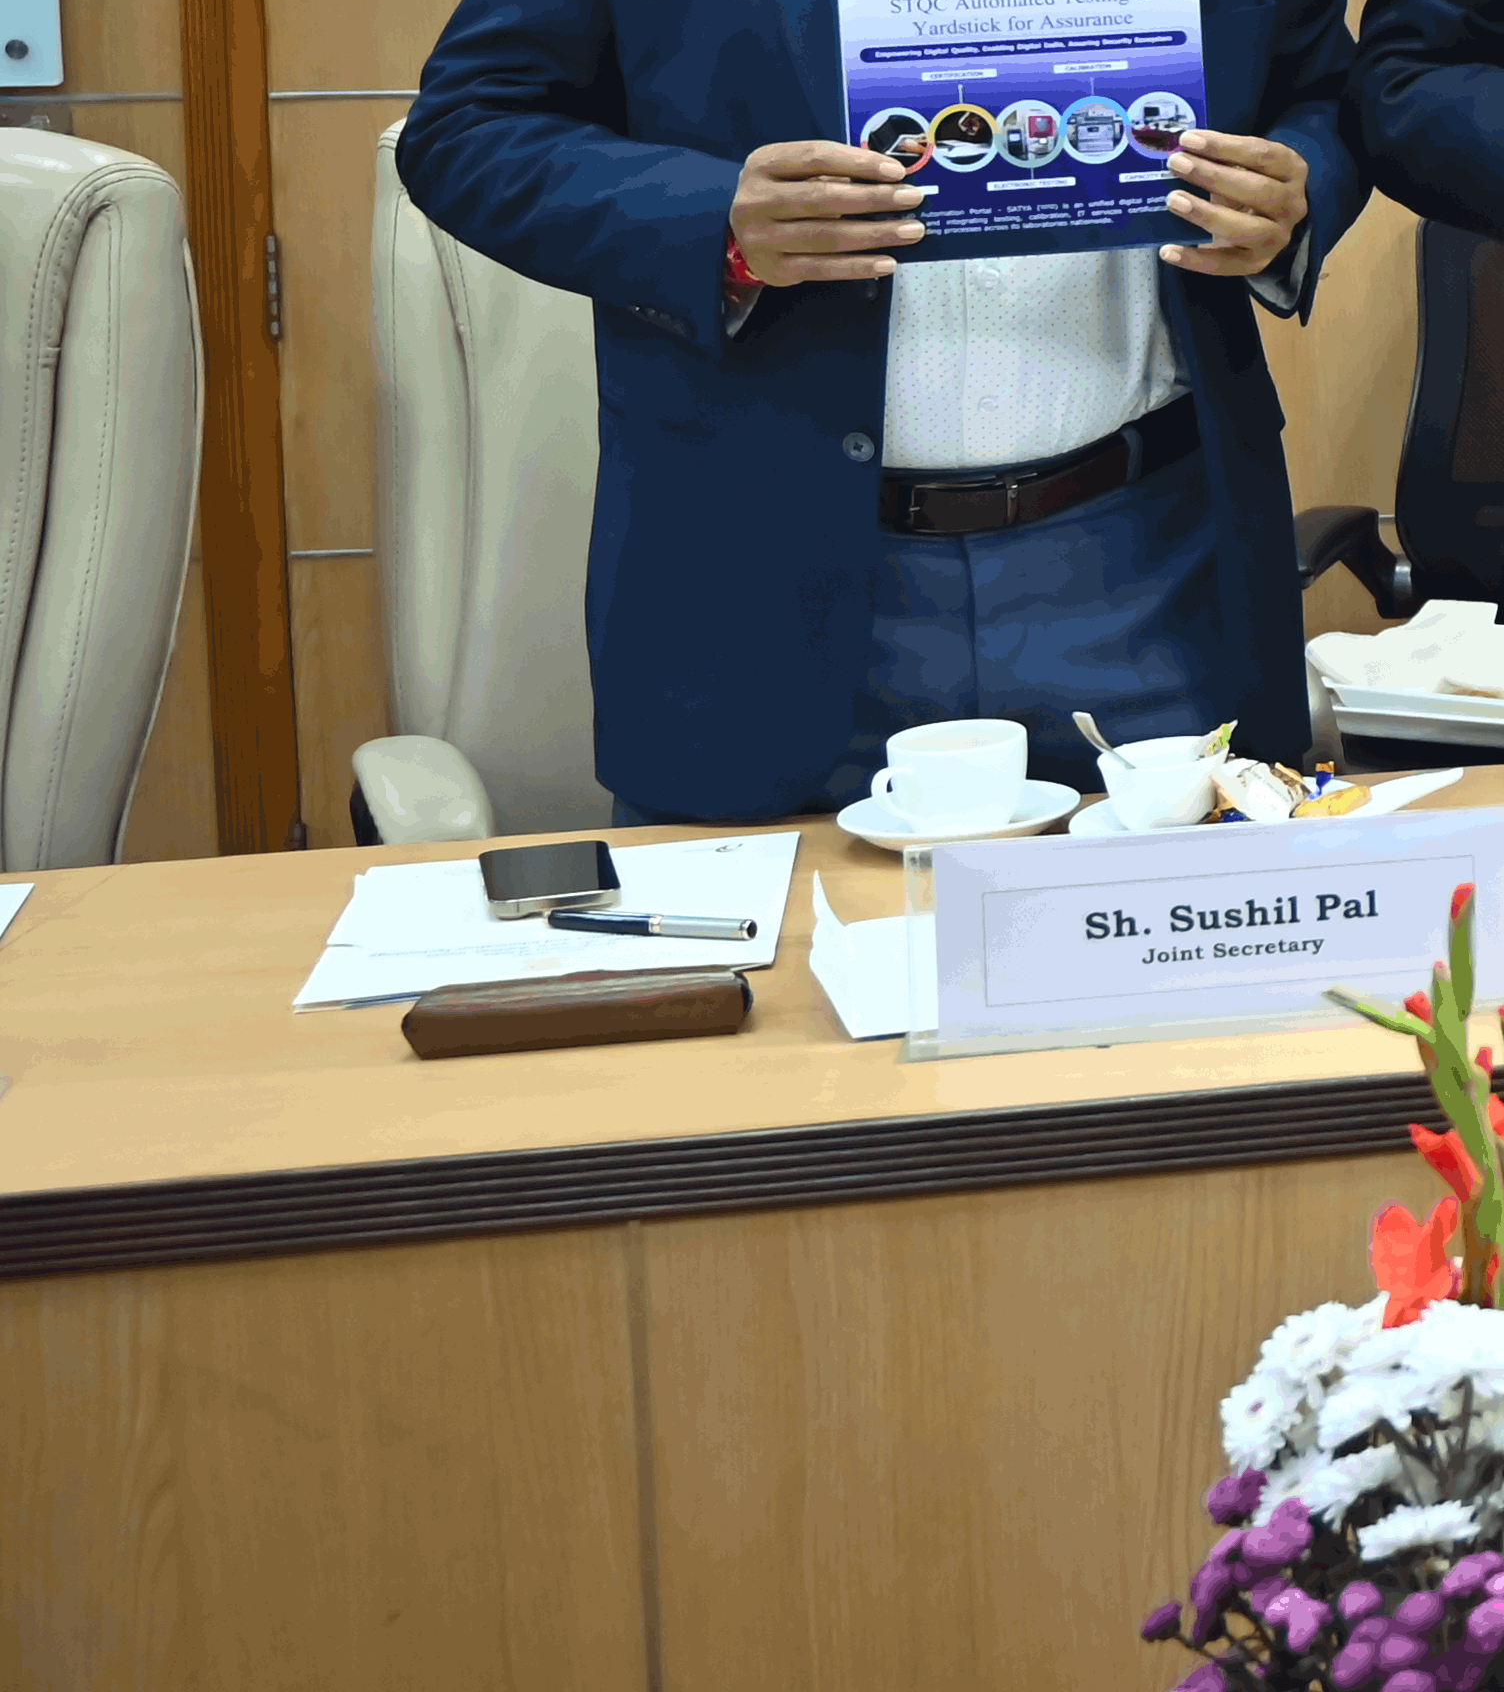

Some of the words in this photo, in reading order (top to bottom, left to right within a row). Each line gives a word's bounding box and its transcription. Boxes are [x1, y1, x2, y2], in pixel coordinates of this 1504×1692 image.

[913, 19, 1002, 37] Yardstick
[1009, 18, 1034, 31] for
[1040, 14, 1134, 29] Assurance
[1085, 910, 1153, 941] Sh.
[1169, 895, 1301, 934] Sushil
[1316, 890, 1380, 921] Pal
[1142, 945, 1204, 965] Joint
[1213, 937, 1324, 959] Secretary
